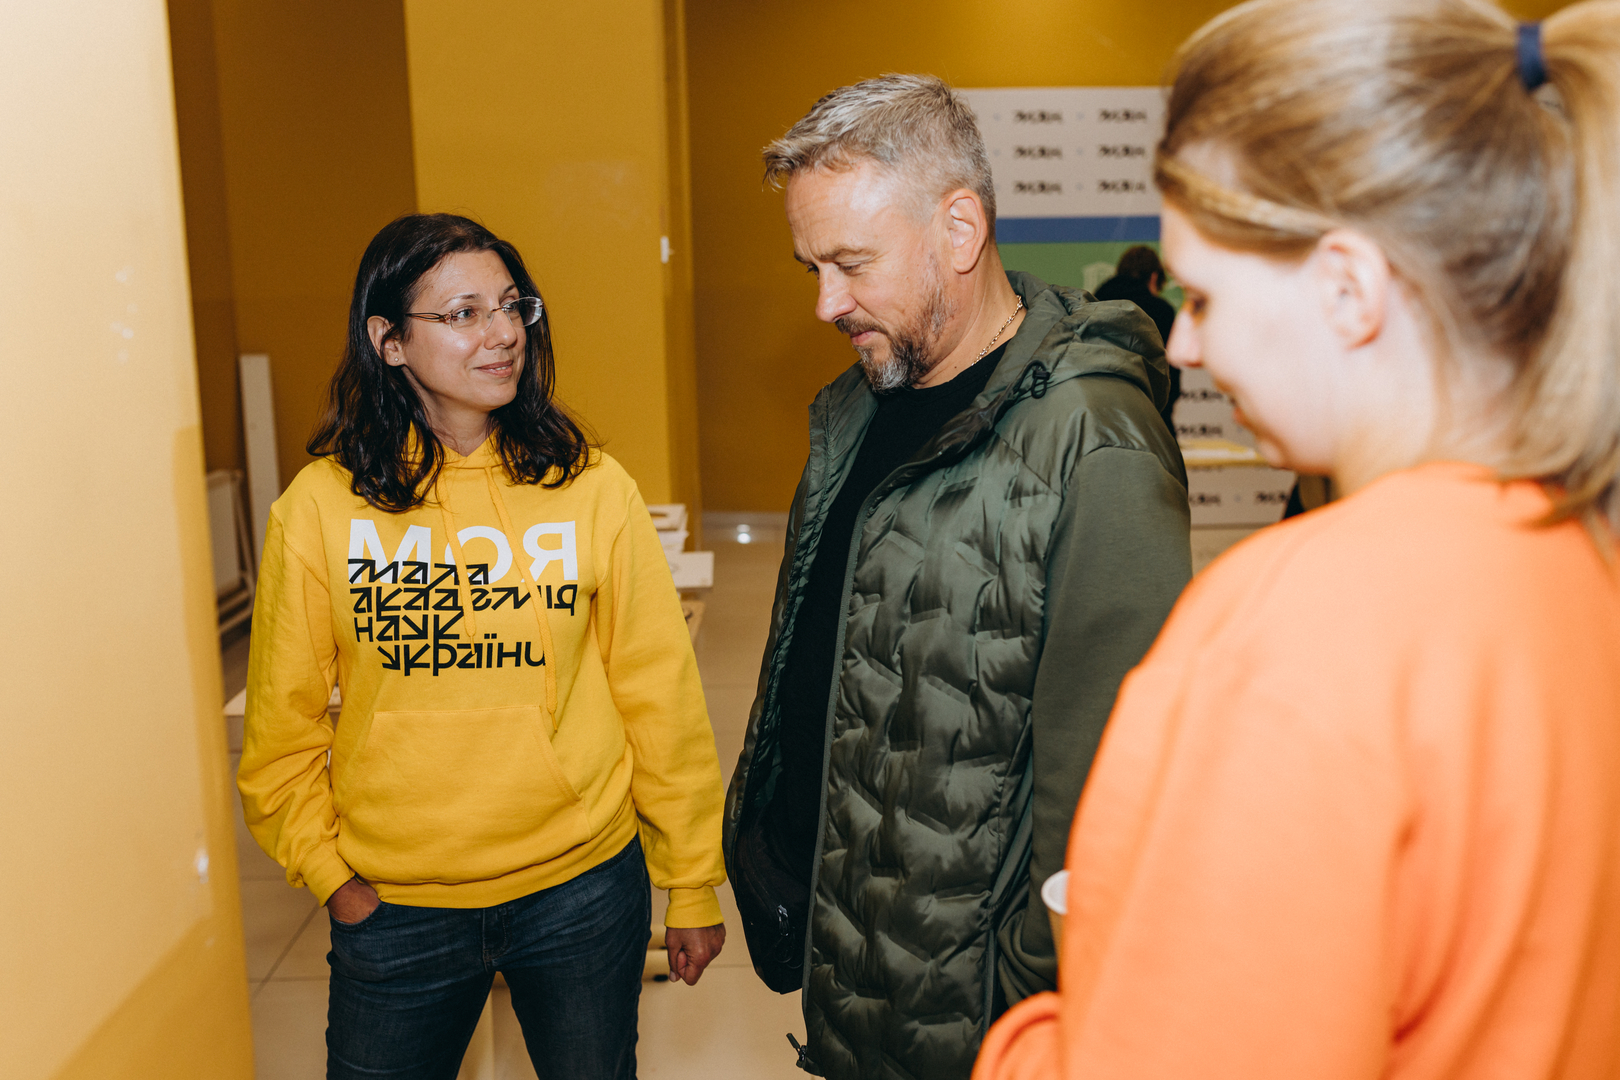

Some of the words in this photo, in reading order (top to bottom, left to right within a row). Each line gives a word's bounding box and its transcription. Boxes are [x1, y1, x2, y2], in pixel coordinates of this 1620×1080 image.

[348, 518, 579, 585] МОЯ
[348, 558, 489, 586] мала
[354, 614, 464, 642] наук
[377, 633, 546, 677] україни
